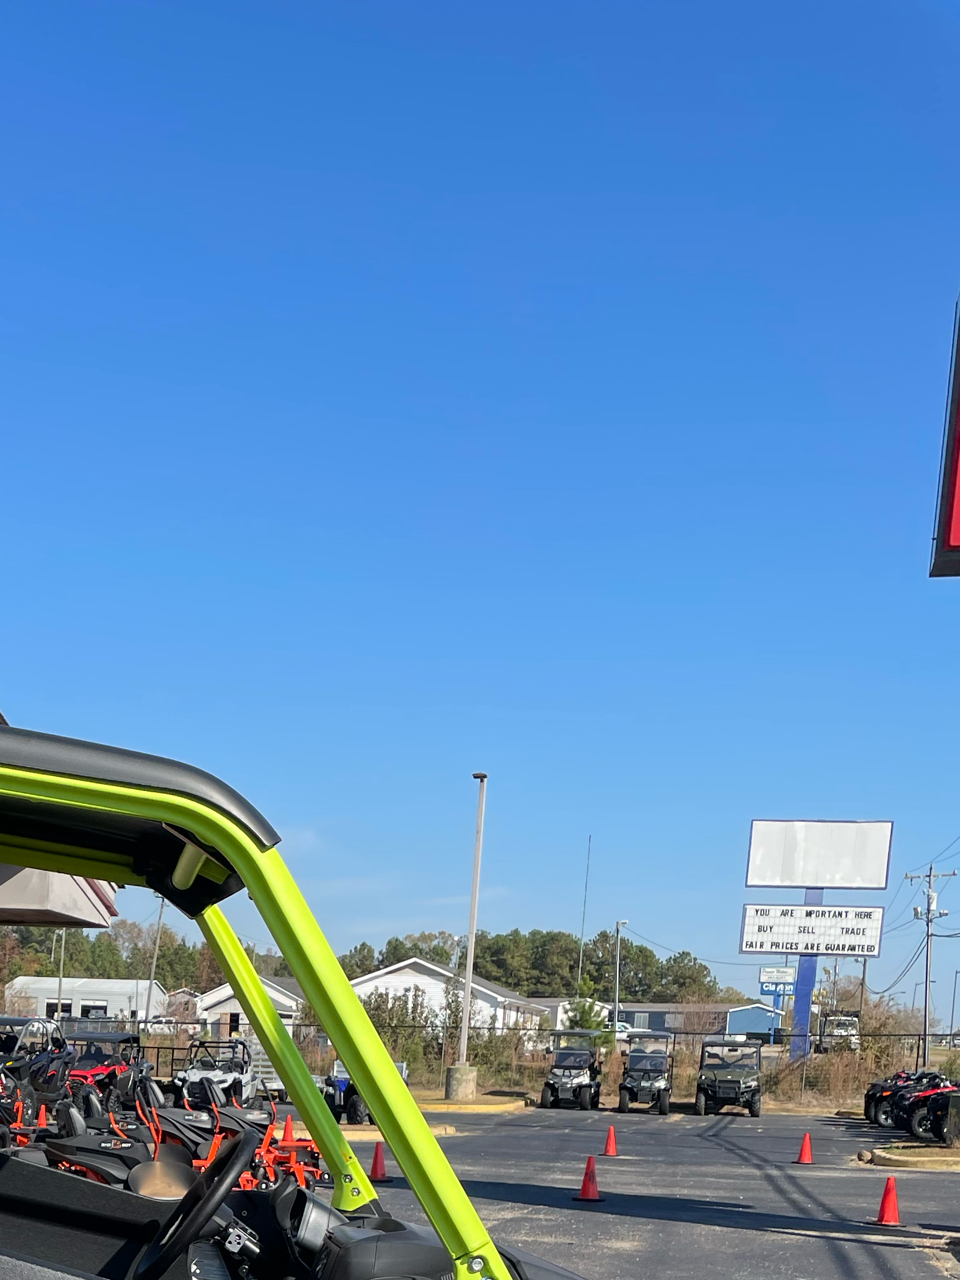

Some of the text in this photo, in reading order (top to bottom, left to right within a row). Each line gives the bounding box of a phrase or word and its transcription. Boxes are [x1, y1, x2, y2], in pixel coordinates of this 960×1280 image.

[755, 909, 770, 917] YOU
[780, 909, 795, 918] ARE
[855, 911, 873, 919] HERE
[758, 925, 867, 936] BUY SELL TRADE
[745, 941, 876, 953] FAIR PRICES ARE GUARANTEED
